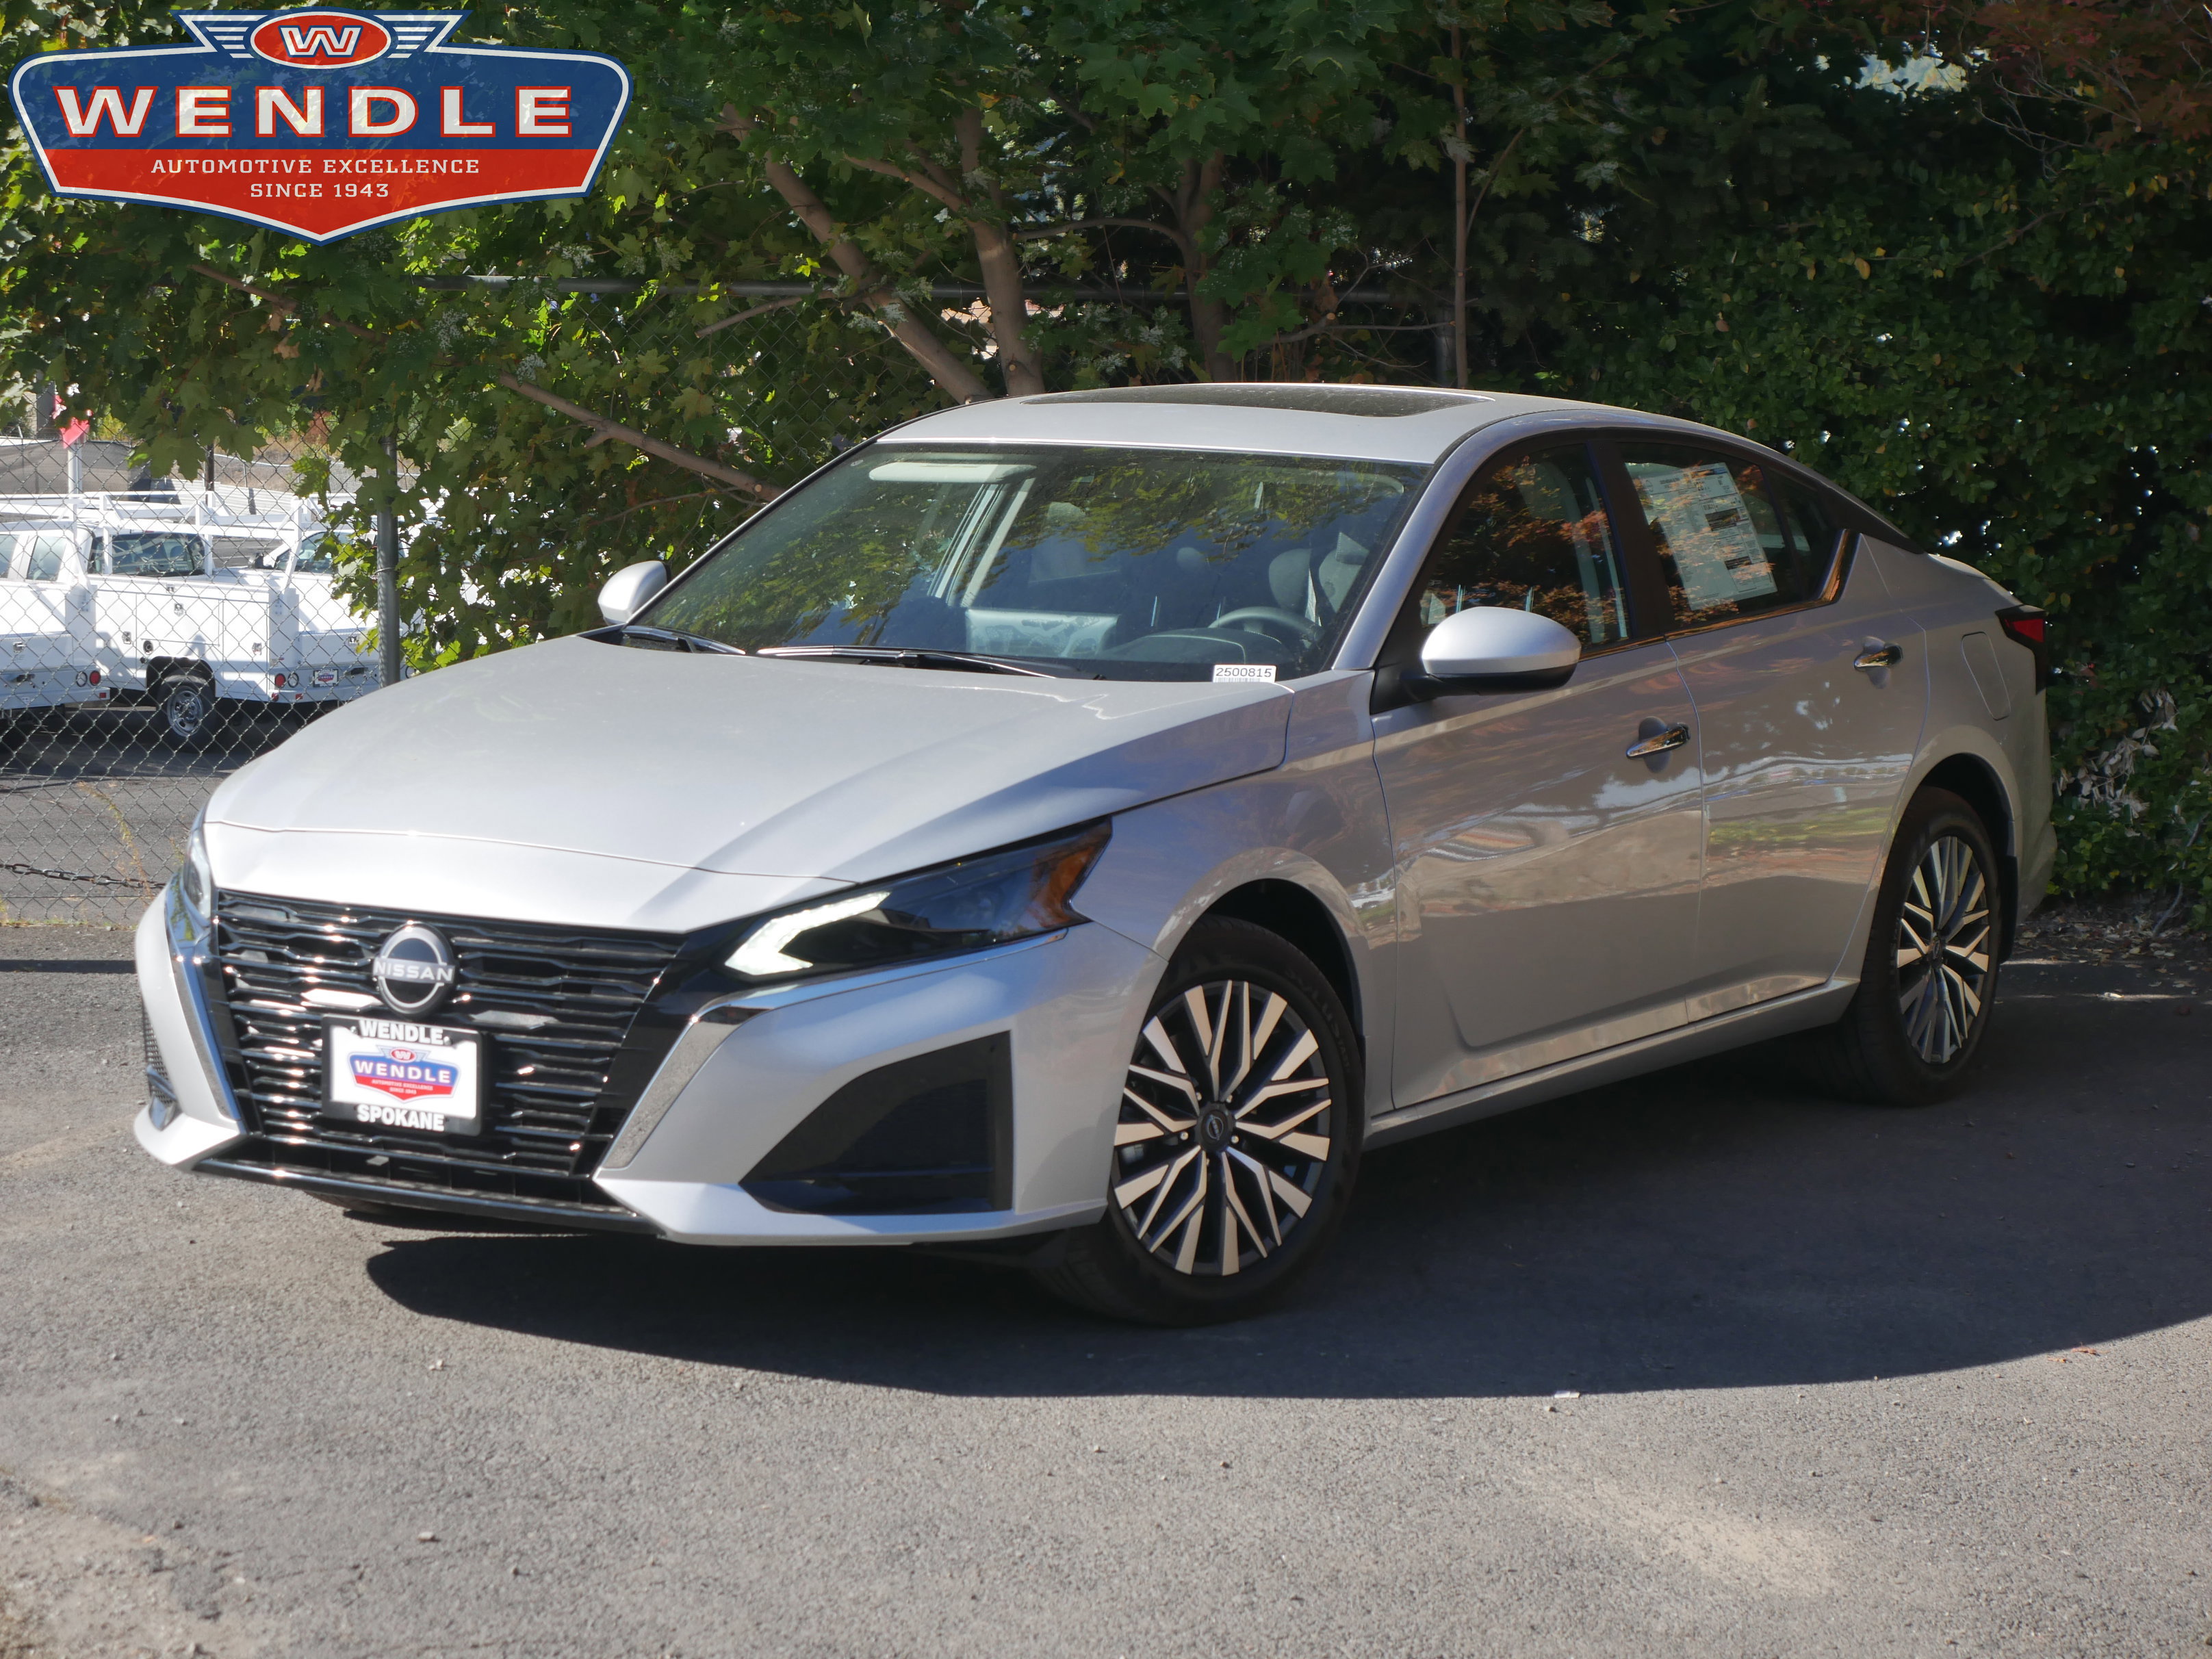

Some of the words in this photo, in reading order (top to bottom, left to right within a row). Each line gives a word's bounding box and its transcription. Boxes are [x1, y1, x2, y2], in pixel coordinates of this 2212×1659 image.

[1216, 667, 1272, 678] 2500815
[374, 962, 453, 981] NISSAN
[360, 1020, 444, 1044] WENDLE
[355, 1061, 450, 1083] WENDLE
[357, 1105, 445, 1131] SPOKANE
